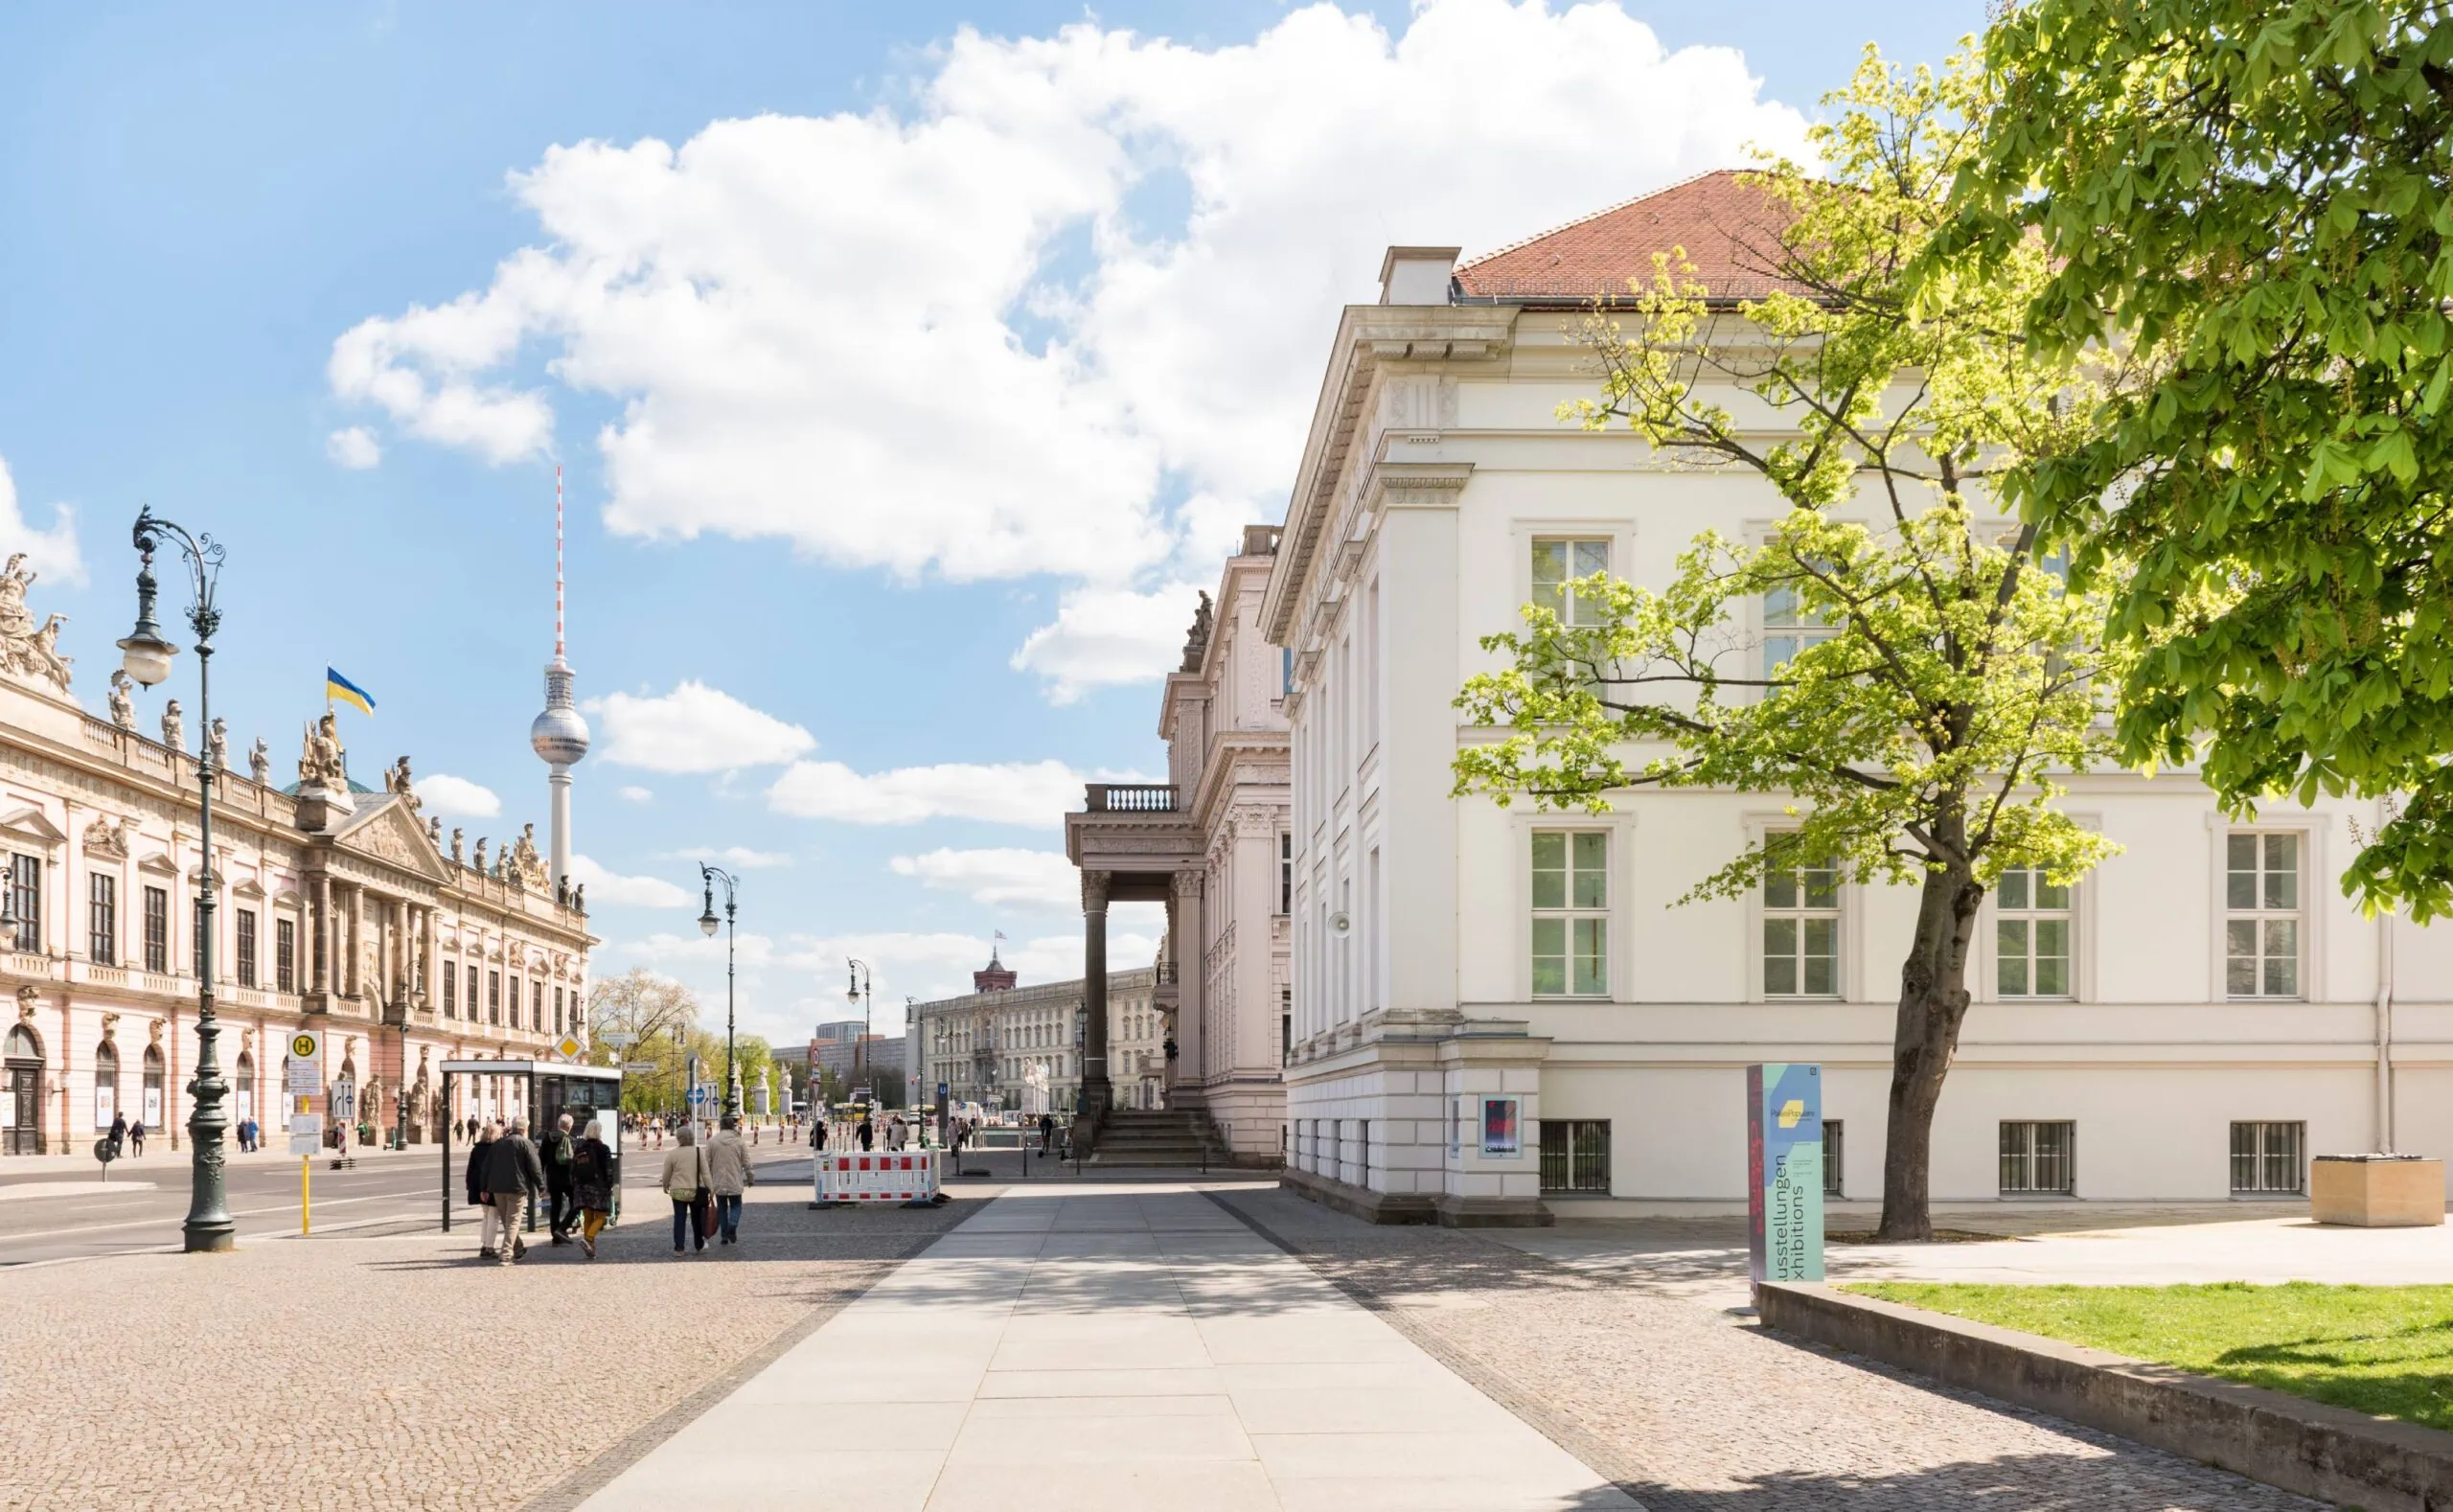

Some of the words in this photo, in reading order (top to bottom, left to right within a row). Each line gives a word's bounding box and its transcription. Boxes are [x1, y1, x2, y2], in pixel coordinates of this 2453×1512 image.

[298, 1040, 309, 1052] H
[1774, 1155, 1790, 1282] usstellungen
[1790, 1185, 1804, 1280] xhibitions
